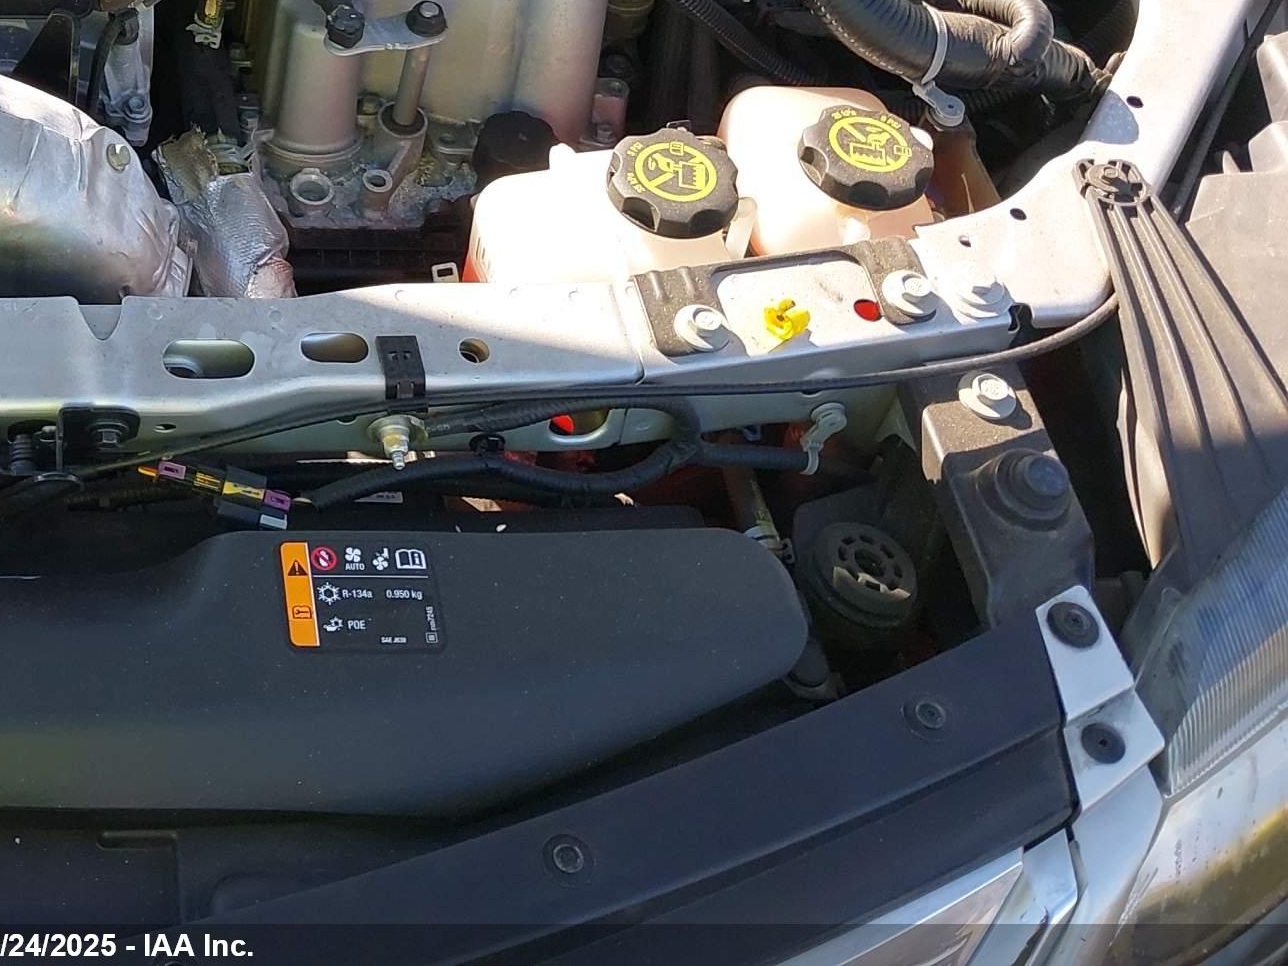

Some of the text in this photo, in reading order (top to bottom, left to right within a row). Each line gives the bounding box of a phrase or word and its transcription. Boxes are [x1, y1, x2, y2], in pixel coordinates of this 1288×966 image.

[345, 562, 365, 571] AUTO
[342, 589, 373, 599] R-134a
[386, 589, 423, 600] 0.950 kg
[347, 619, 366, 630] POE
